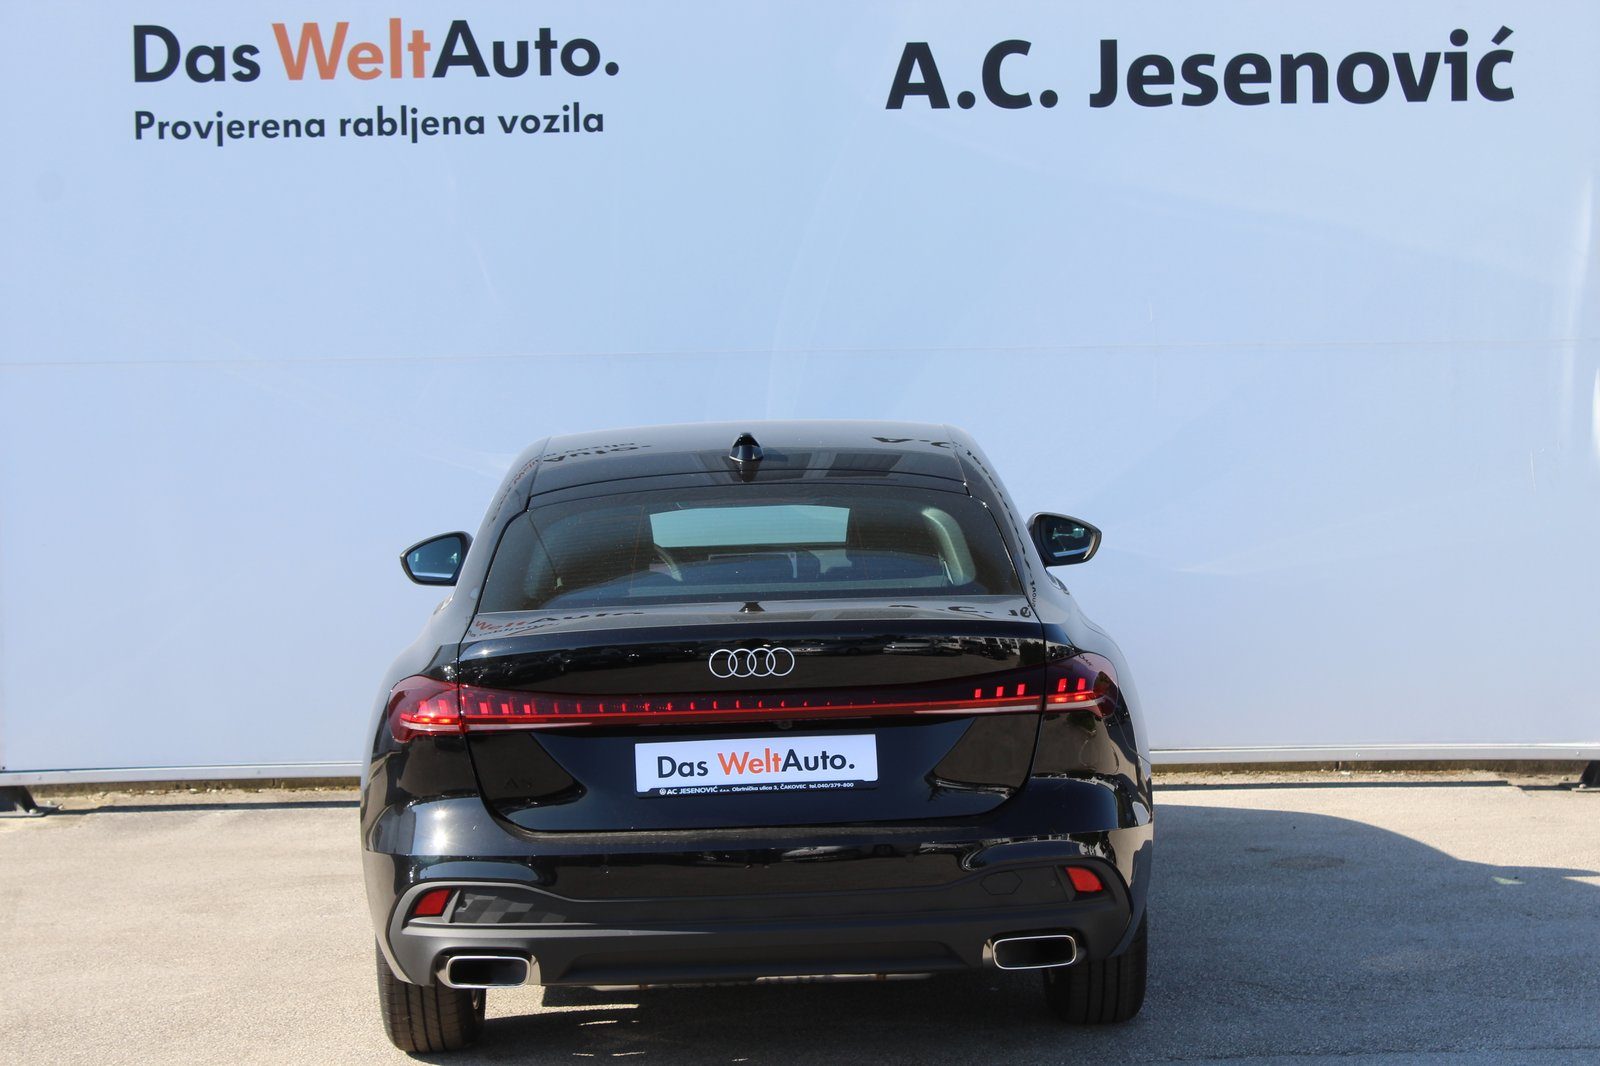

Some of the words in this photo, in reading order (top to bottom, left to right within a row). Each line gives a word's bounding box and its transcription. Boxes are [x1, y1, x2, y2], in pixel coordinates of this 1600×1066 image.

[134, 25, 260, 83] Das
[272, 18, 620, 81] WeltAuto.
[885, 40, 1059, 110] A.C.
[1089, 25, 1515, 108] Jesenović
[134, 110, 325, 147] Provjerena
[339, 105, 485, 144] rabljena
[498, 101, 604, 135] vozila
[657, 755, 709, 779] Das
[717, 747, 856, 776] WeltAuto.
[679, 786, 718, 794] JESENOVIĆ
